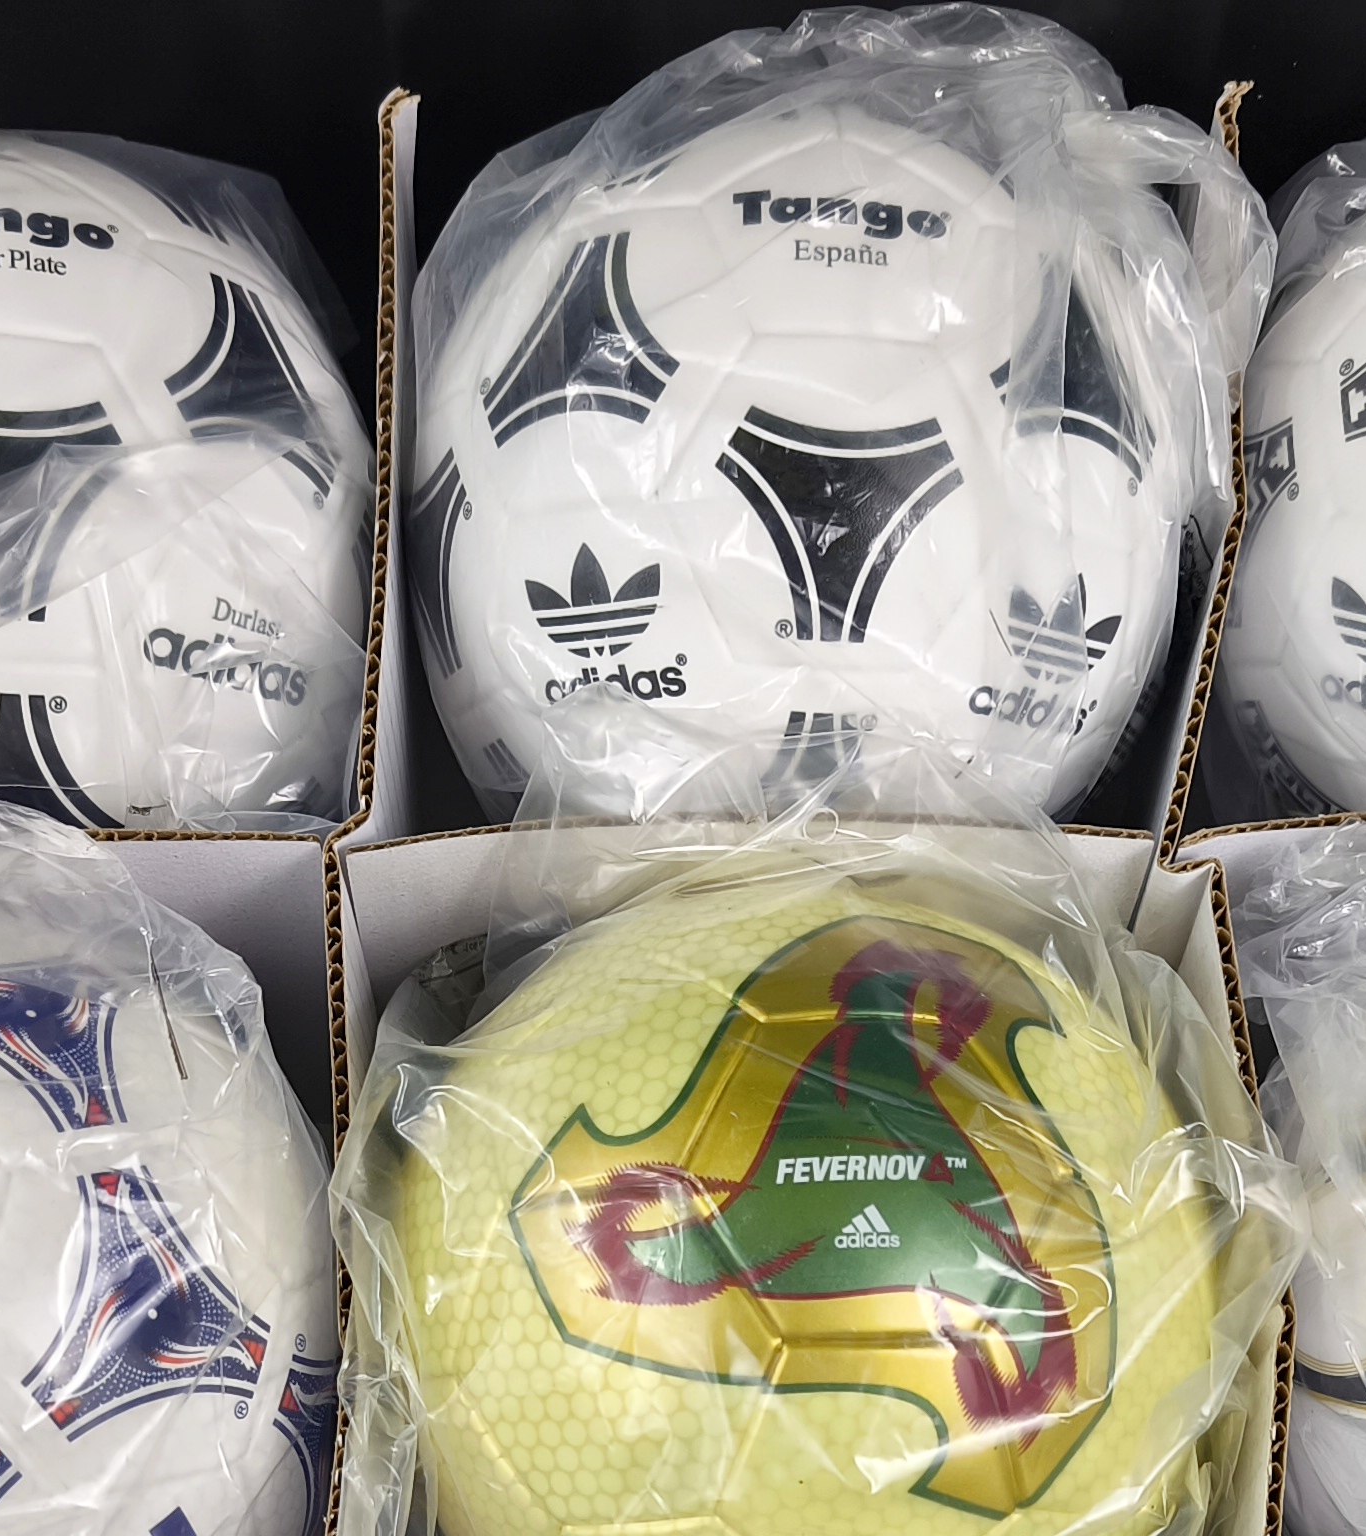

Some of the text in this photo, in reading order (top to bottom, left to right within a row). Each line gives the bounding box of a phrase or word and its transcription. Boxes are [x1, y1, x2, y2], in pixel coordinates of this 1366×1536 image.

[733, 190, 946, 239] Tango
[9, 248, 66, 276] Plate
[795, 239, 889, 267] España
[834, 1232, 901, 1248] adidas
